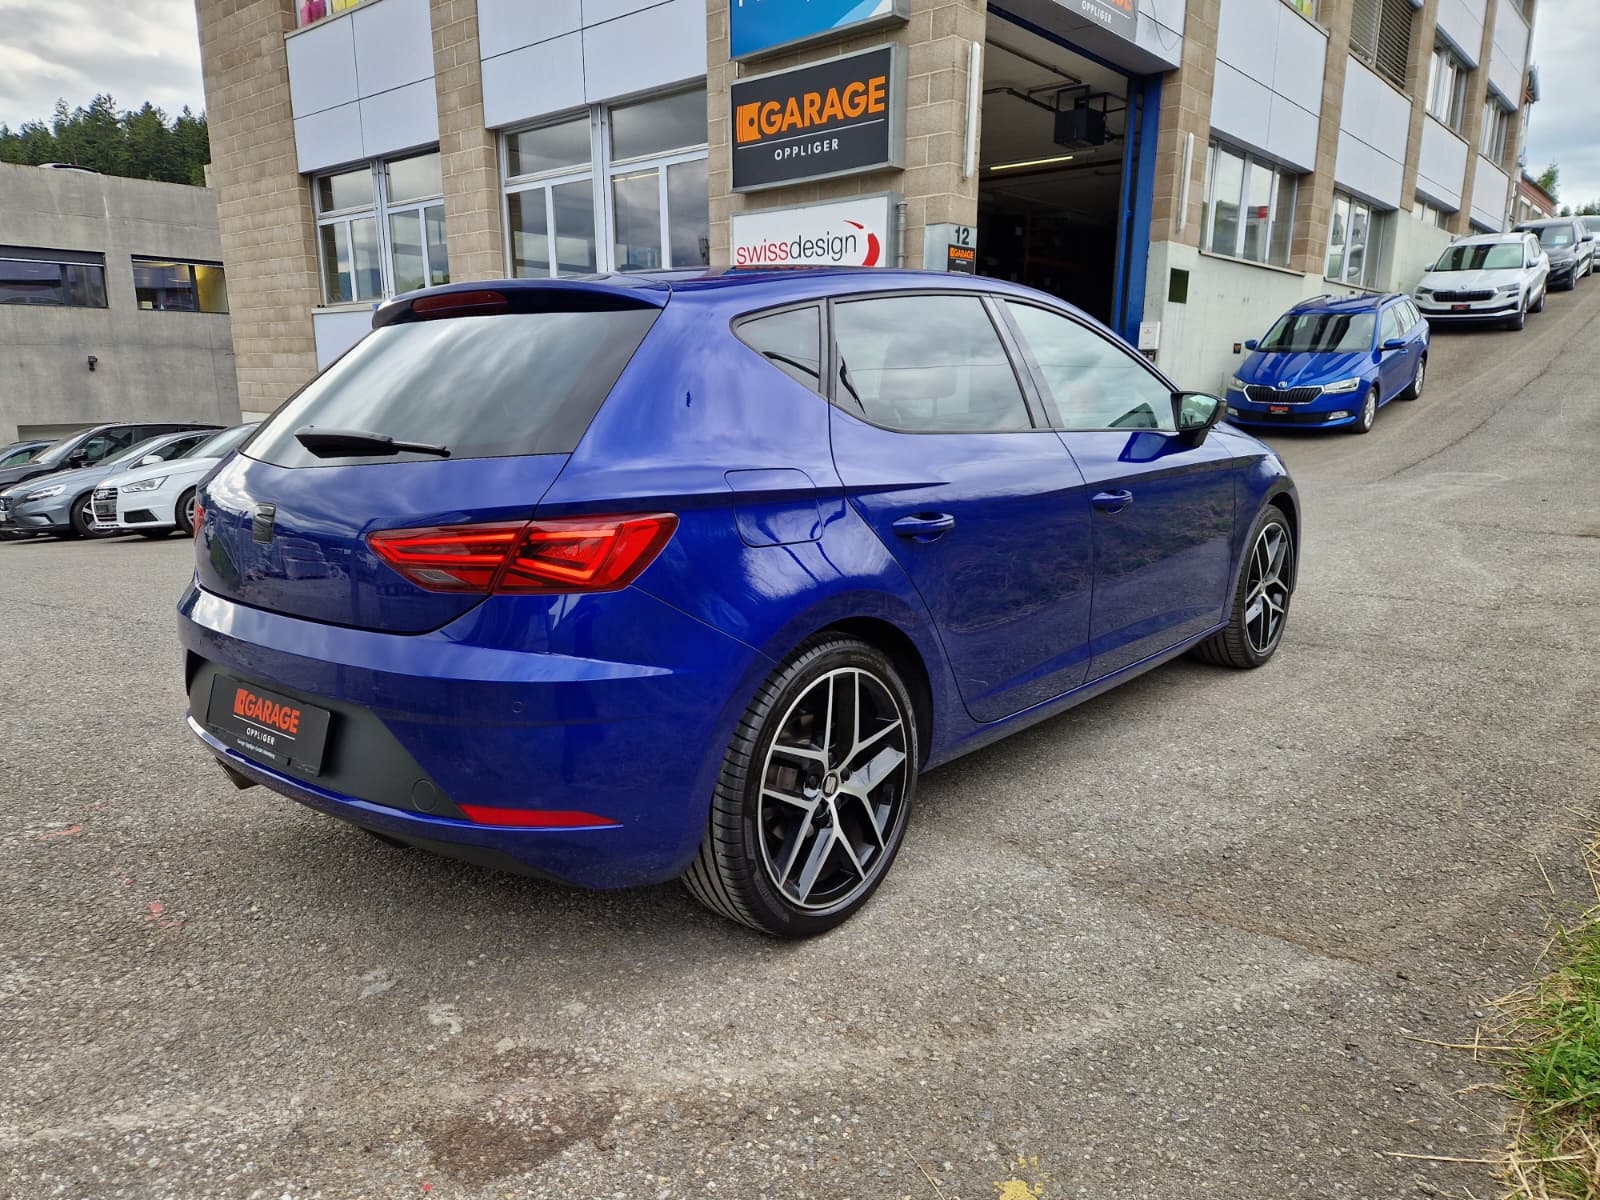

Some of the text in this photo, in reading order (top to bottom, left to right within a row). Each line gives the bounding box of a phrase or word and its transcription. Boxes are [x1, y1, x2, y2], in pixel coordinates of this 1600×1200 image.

[1081, 0, 1112, 24] OPPLIGER
[760, 75, 886, 136] GARAGE
[774, 138, 839, 161] OPPLIGER
[955, 225, 970, 245] 12
[736, 231, 857, 265] swissdesign
[954, 248, 974, 260] GARAGE
[244, 694, 301, 734] GARAGE
[246, 727, 275, 746] OPPLIGER
